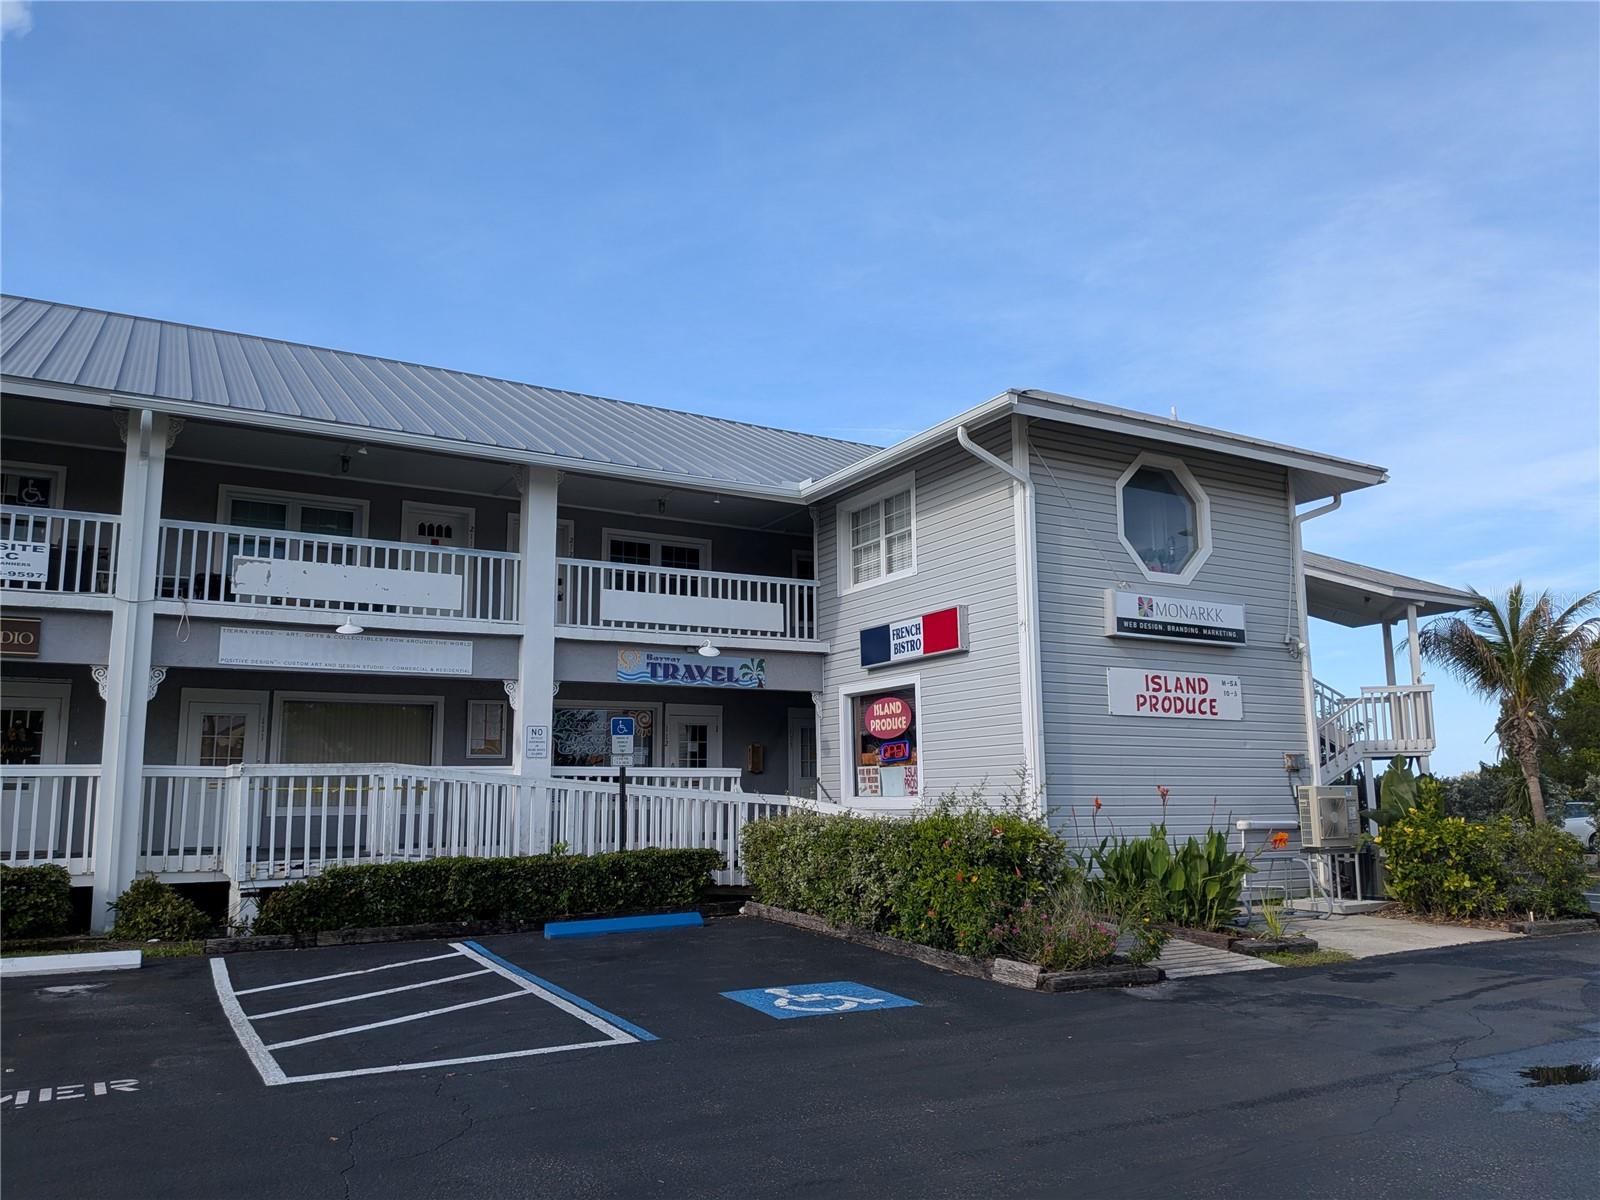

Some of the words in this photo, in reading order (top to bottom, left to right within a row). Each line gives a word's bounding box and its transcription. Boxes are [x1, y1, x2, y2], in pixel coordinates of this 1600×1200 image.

[1155, 601, 1225, 623] MONARKK
[892, 623, 922, 641] FRENCH
[1123, 621, 1138, 629] WEB
[894, 638, 921, 655] BISTRO
[646, 653, 681, 663] Bayway
[646, 661, 740, 683] TRAVEL
[1144, 673, 1209, 696] ISLAND
[873, 701, 902, 717] ISLAND
[1136, 694, 1219, 716] PRODUCE
[531, 728, 543, 736] NO
[870, 716, 906, 732] PRODUCE
[883, 743, 908, 760] OPEN
